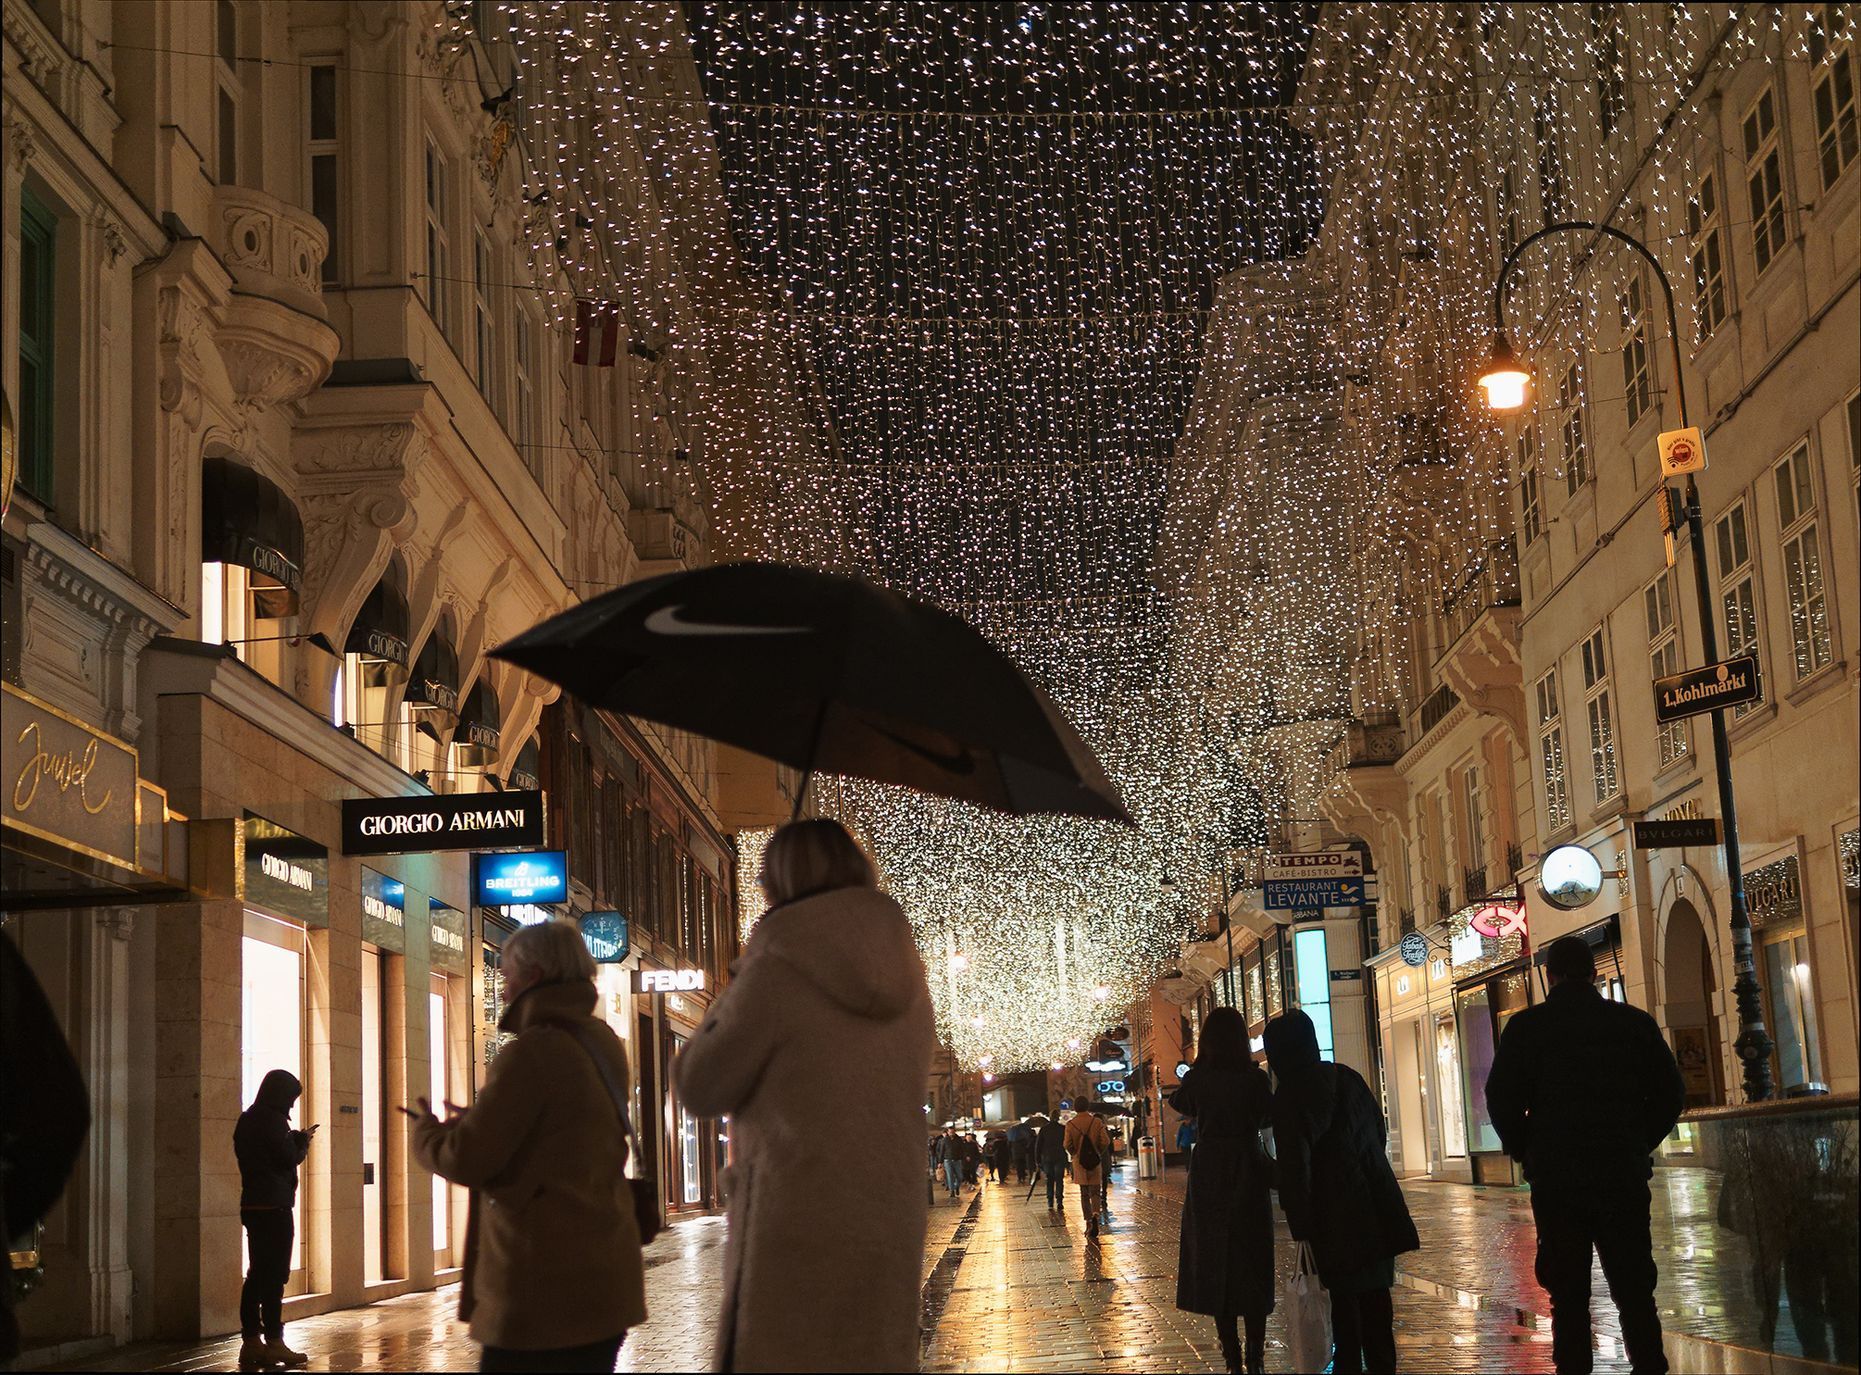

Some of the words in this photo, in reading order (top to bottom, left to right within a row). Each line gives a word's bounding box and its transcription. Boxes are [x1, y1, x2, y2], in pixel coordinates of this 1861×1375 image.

[360, 812, 444, 836] GIORGIO
[449, 809, 525, 831] ARMANI
[1638, 827, 1714, 840] BVLGARI
[1282, 855, 1341, 866] TEMPO
[485, 876, 561, 889] BREITLING
[1267, 881, 1338, 893] RESTAURANT
[1268, 891, 1340, 907] LEVANTE
[641, 969, 704, 992] FENDI
